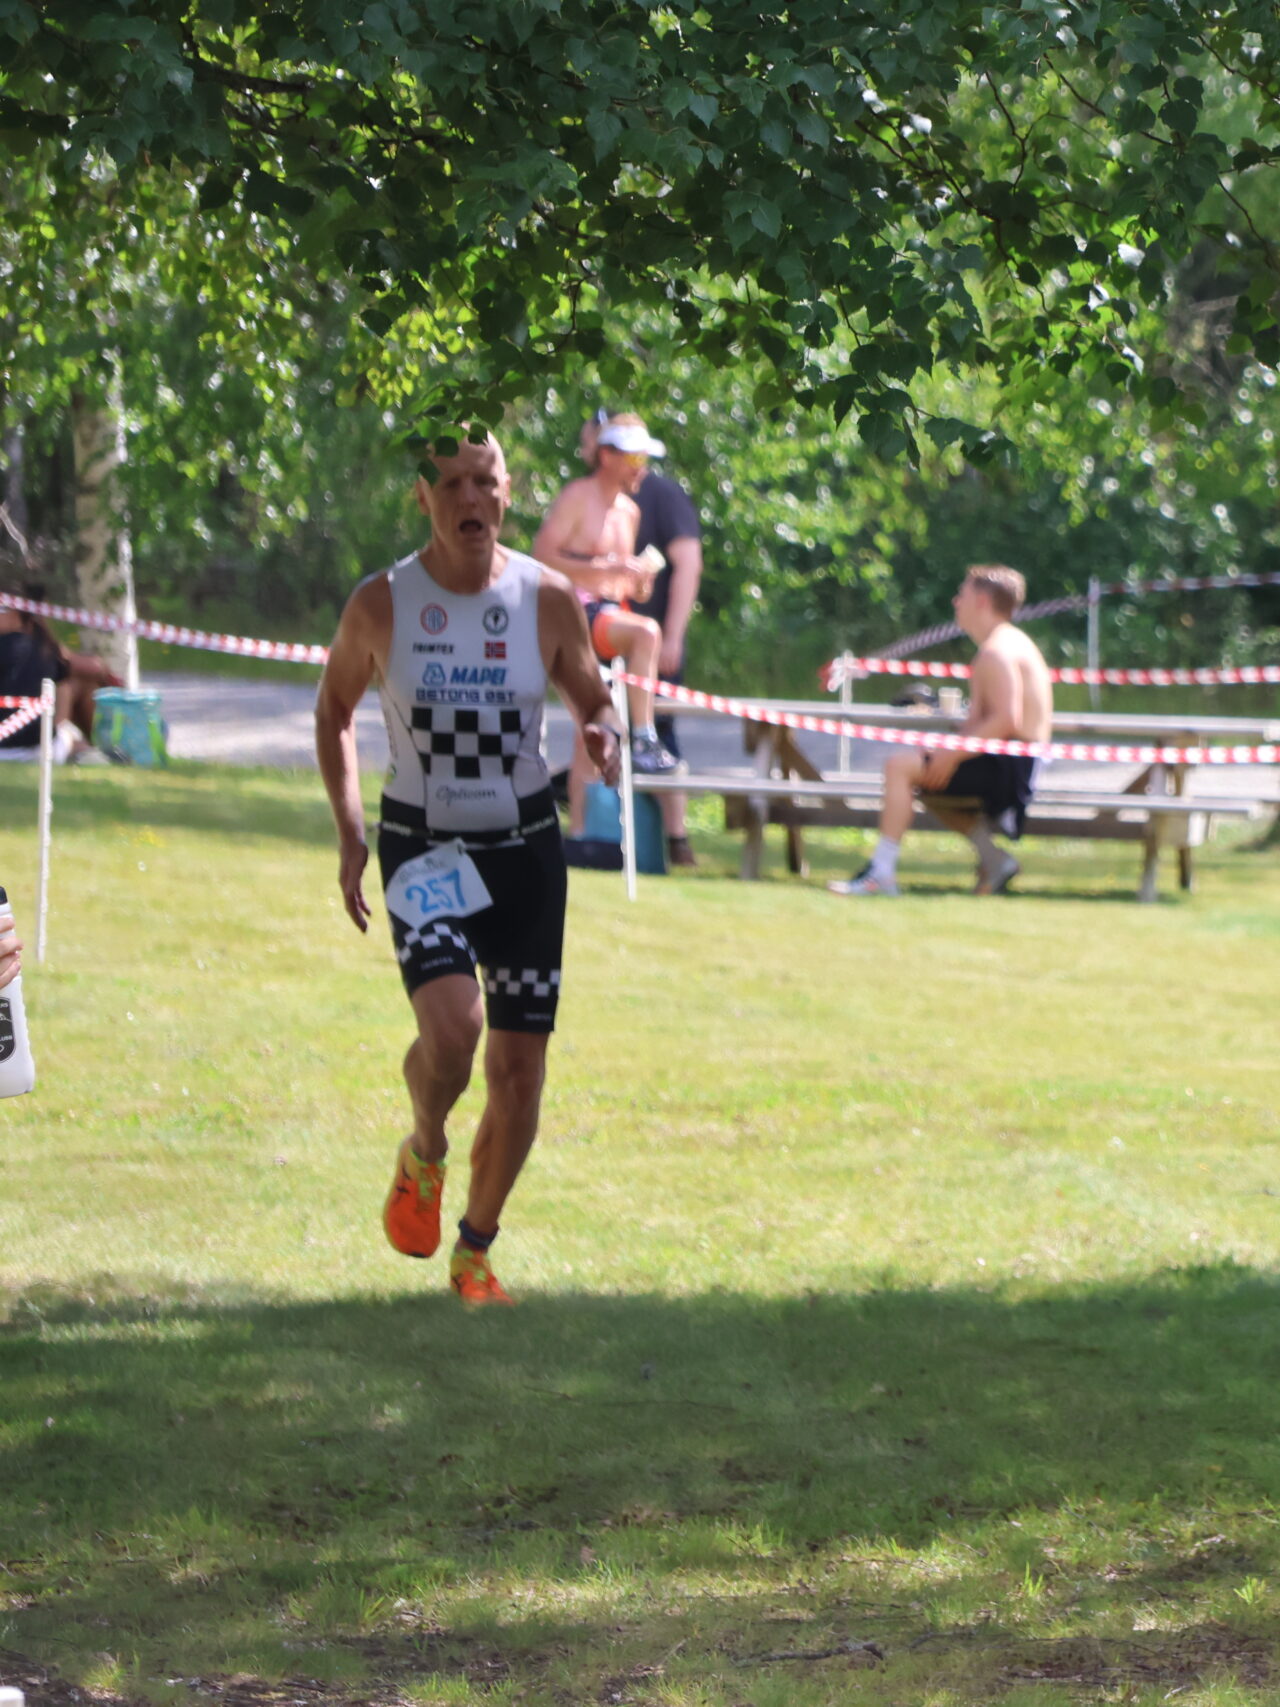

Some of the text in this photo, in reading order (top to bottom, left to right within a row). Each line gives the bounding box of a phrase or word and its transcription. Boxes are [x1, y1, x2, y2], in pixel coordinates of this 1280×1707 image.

[450, 666, 508, 686] MAPEI
[415, 688, 480, 703] BETONG
[405, 868, 467, 914] 257
